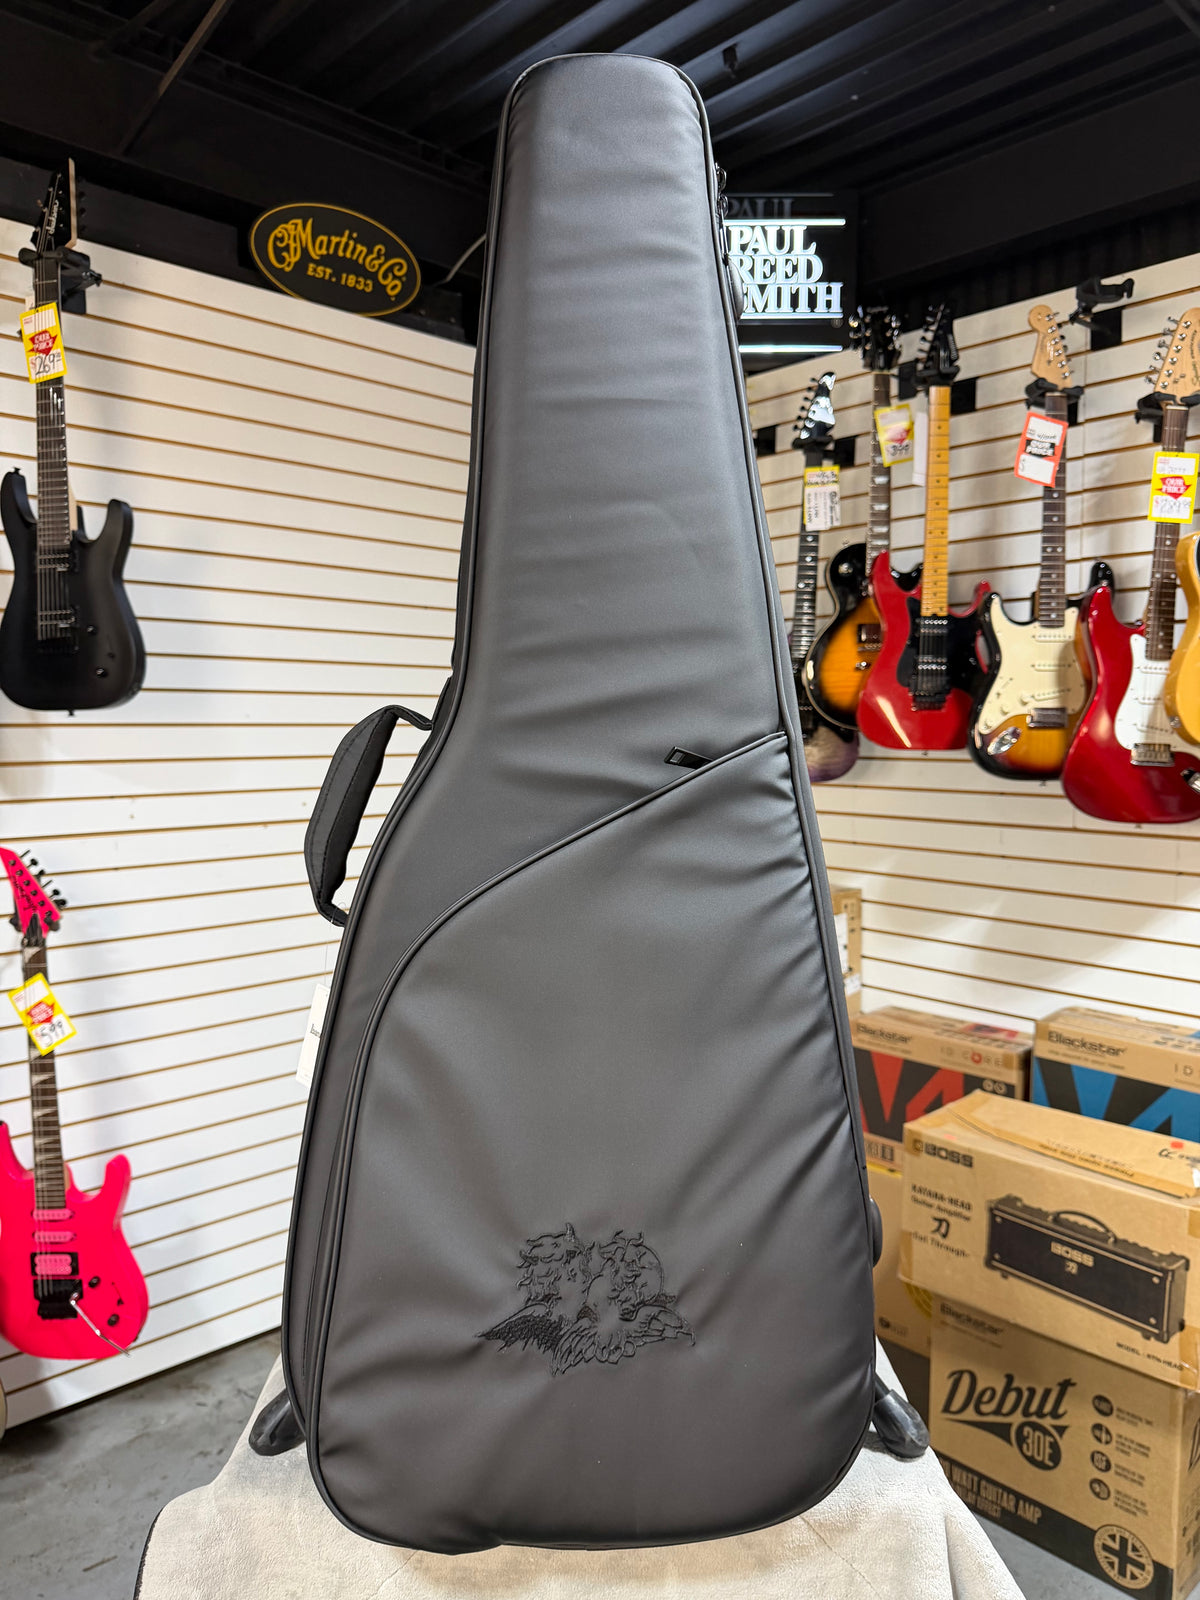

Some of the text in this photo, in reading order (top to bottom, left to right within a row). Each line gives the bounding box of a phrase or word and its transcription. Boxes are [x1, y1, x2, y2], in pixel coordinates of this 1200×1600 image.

[728, 225, 817, 256] PAUL
[306, 263, 374, 293] EST. 1833
[729, 254, 823, 284] REED
[743, 282, 844, 313] MITH
[1047, 1030, 1128, 1057] Blackstar
[924, 1142, 974, 1168] BOSS
[1051, 1241, 1095, 1268] BOSS
[941, 1368, 1077, 1420] Debut
[1021, 1430, 1055, 1469] 30E
[1017, 1500, 1042, 1525] AMP
